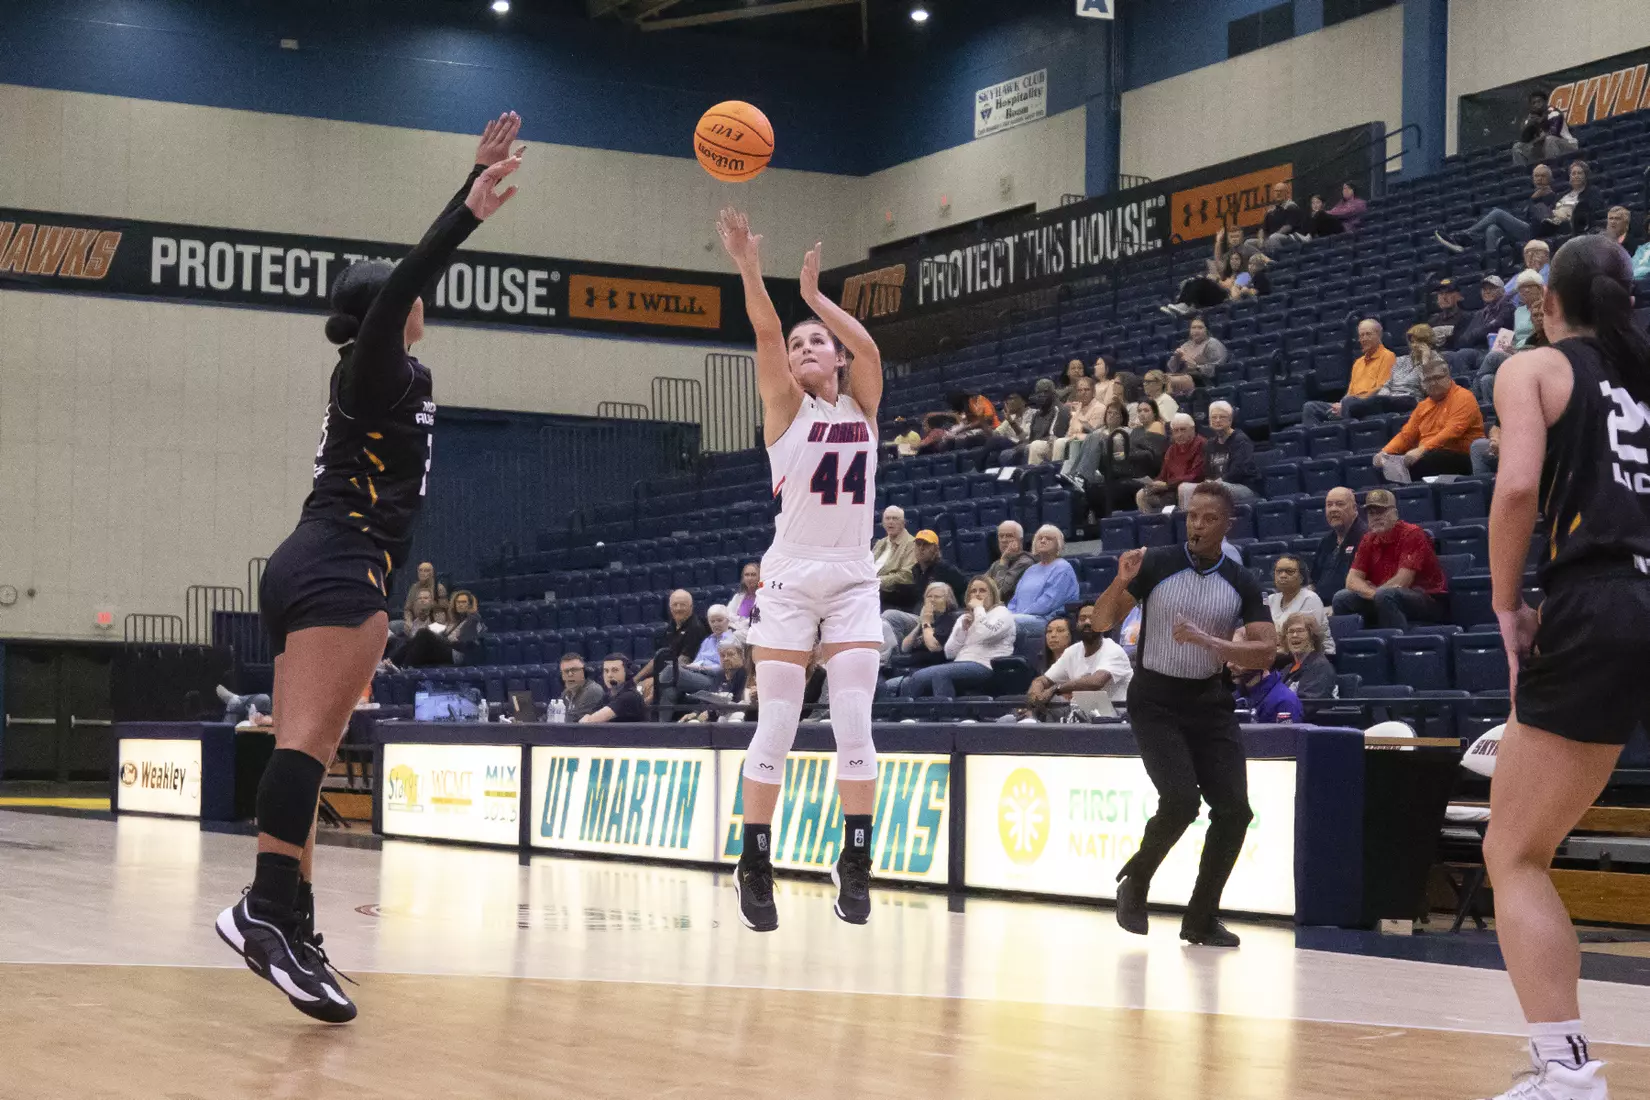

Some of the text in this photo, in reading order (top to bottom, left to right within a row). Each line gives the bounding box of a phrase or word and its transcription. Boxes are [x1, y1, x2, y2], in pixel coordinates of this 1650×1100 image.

[995, 87, 1042, 110] Hospitality
[698, 142, 745, 170] Wilson
[151, 236, 335, 298] PROTECT
[919, 234, 1019, 305] PROTECT
[1023, 222, 1064, 281] THIS
[810, 450, 868, 505] 44
[141, 761, 187, 795] Weakley
[485, 765, 517, 785] MIX
[540, 756, 702, 850] UT MARTIN
[723, 757, 950, 876] SYHAKS
[1069, 787, 1134, 823] FIRST
[1068, 830, 1147, 862] NATIO
